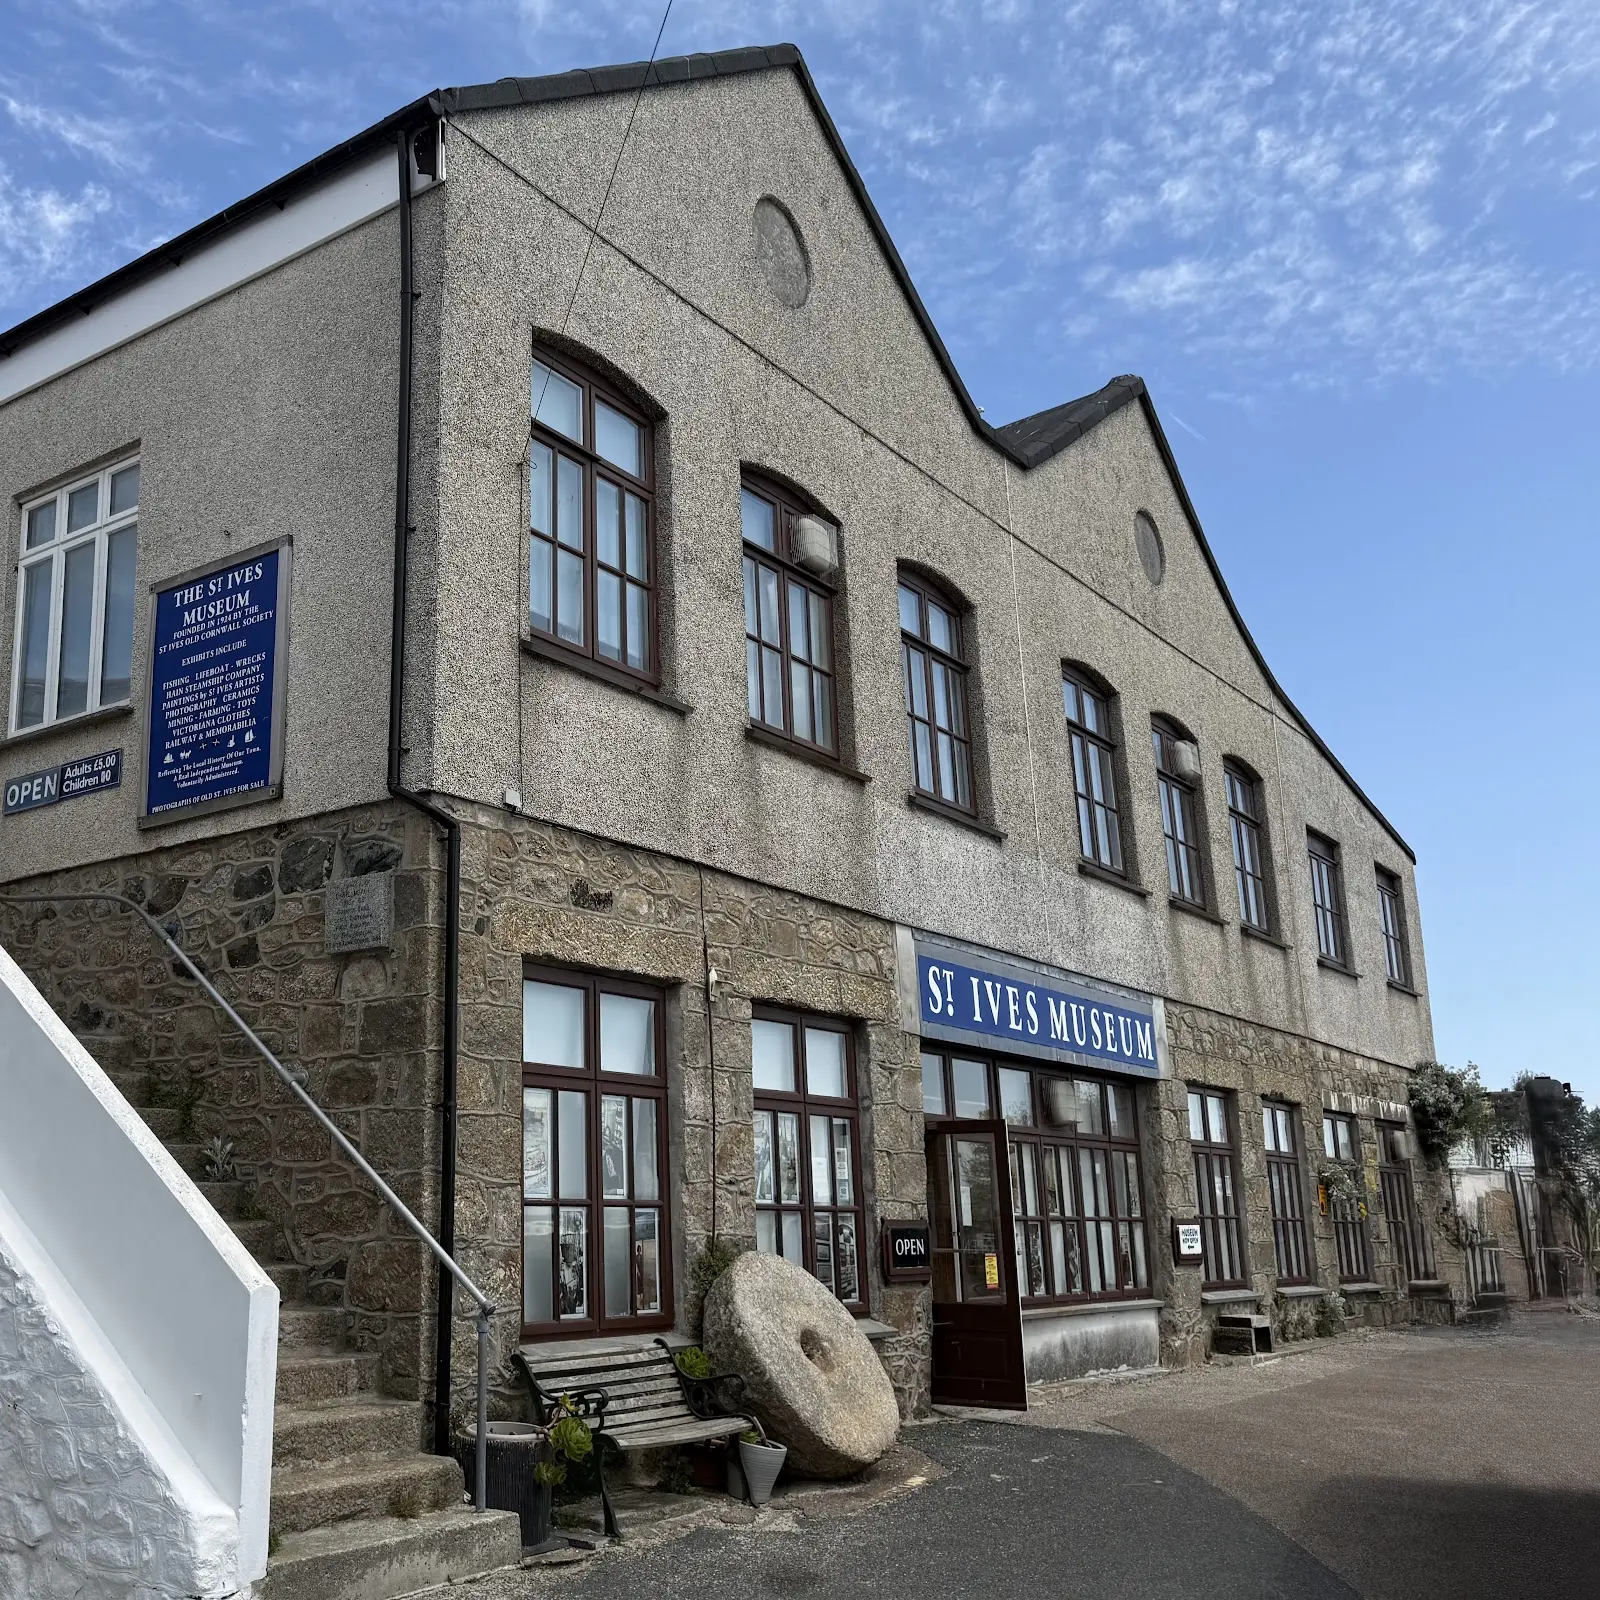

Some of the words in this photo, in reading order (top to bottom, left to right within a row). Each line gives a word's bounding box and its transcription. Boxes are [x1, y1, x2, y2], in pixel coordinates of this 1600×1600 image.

[174, 584, 203, 607] THE
[228, 563, 262, 589] IVES
[174, 624, 205, 639] FOUNDED
[208, 620, 215, 628] IN
[217, 615, 232, 625] 1924
[234, 611, 242, 620] BY
[245, 605, 258, 616] THE
[183, 590, 250, 626] MUSEUM
[159, 645, 166, 654] ST
[169, 640, 183, 651] IVES
[185, 634, 199, 645] OLD
[201, 624, 240, 640] CORNWALL
[243, 610, 274, 626] SOCIETY
[182, 649, 214, 666] EXHIBITS
[216, 639, 247, 655] INCLUDE
[163, 676, 189, 690] FISHING
[196, 663, 229, 680] LIFEBOAT
[236, 652, 266, 666] WRECKS
[166, 689, 183, 699] HAIN
[185, 675, 223, 693] STEAMSHIP
[225, 664, 261, 681] COMPANY
[162, 693, 198, 710] PAINTINGS
[200, 691, 207, 700] by
[217, 683, 232, 695] IVES
[234, 673, 264, 689] ARTISTS
[166, 698, 217, 719] PHOTOGRAPHY
[223, 685, 260, 702] CERAMICS
[168, 715, 193, 728] MINING
[199, 704, 231, 719] FARMING
[238, 697, 256, 708] TOYS
[173, 719, 215, 736] VICTORIANA
[217, 709, 250, 724] CLOTHES
[165, 734, 197, 749] RAILWAY
[206, 718, 256, 738] MEMORABILIA
[64, 763, 91, 779] Adults
[93, 755, 116, 771] £5.00
[179, 772, 189, 780] Real
[183, 763, 192, 772] The
[193, 759, 206, 768] Local
[207, 756, 225, 764] History
[7, 774, 57, 806] OPEN
[63, 776, 98, 792] Children
[152, 798, 191, 813] PHOTOGRAPHS
[201, 793, 212, 801] OLD
[224, 787, 236, 795] IVES
[238, 784, 248, 792] FOR
[250, 780, 264, 789] SALE
[970, 976, 1038, 1035] IVES
[1048, 997, 1154, 1060] MUSEUM
[896, 1239, 924, 1255] OPEN
